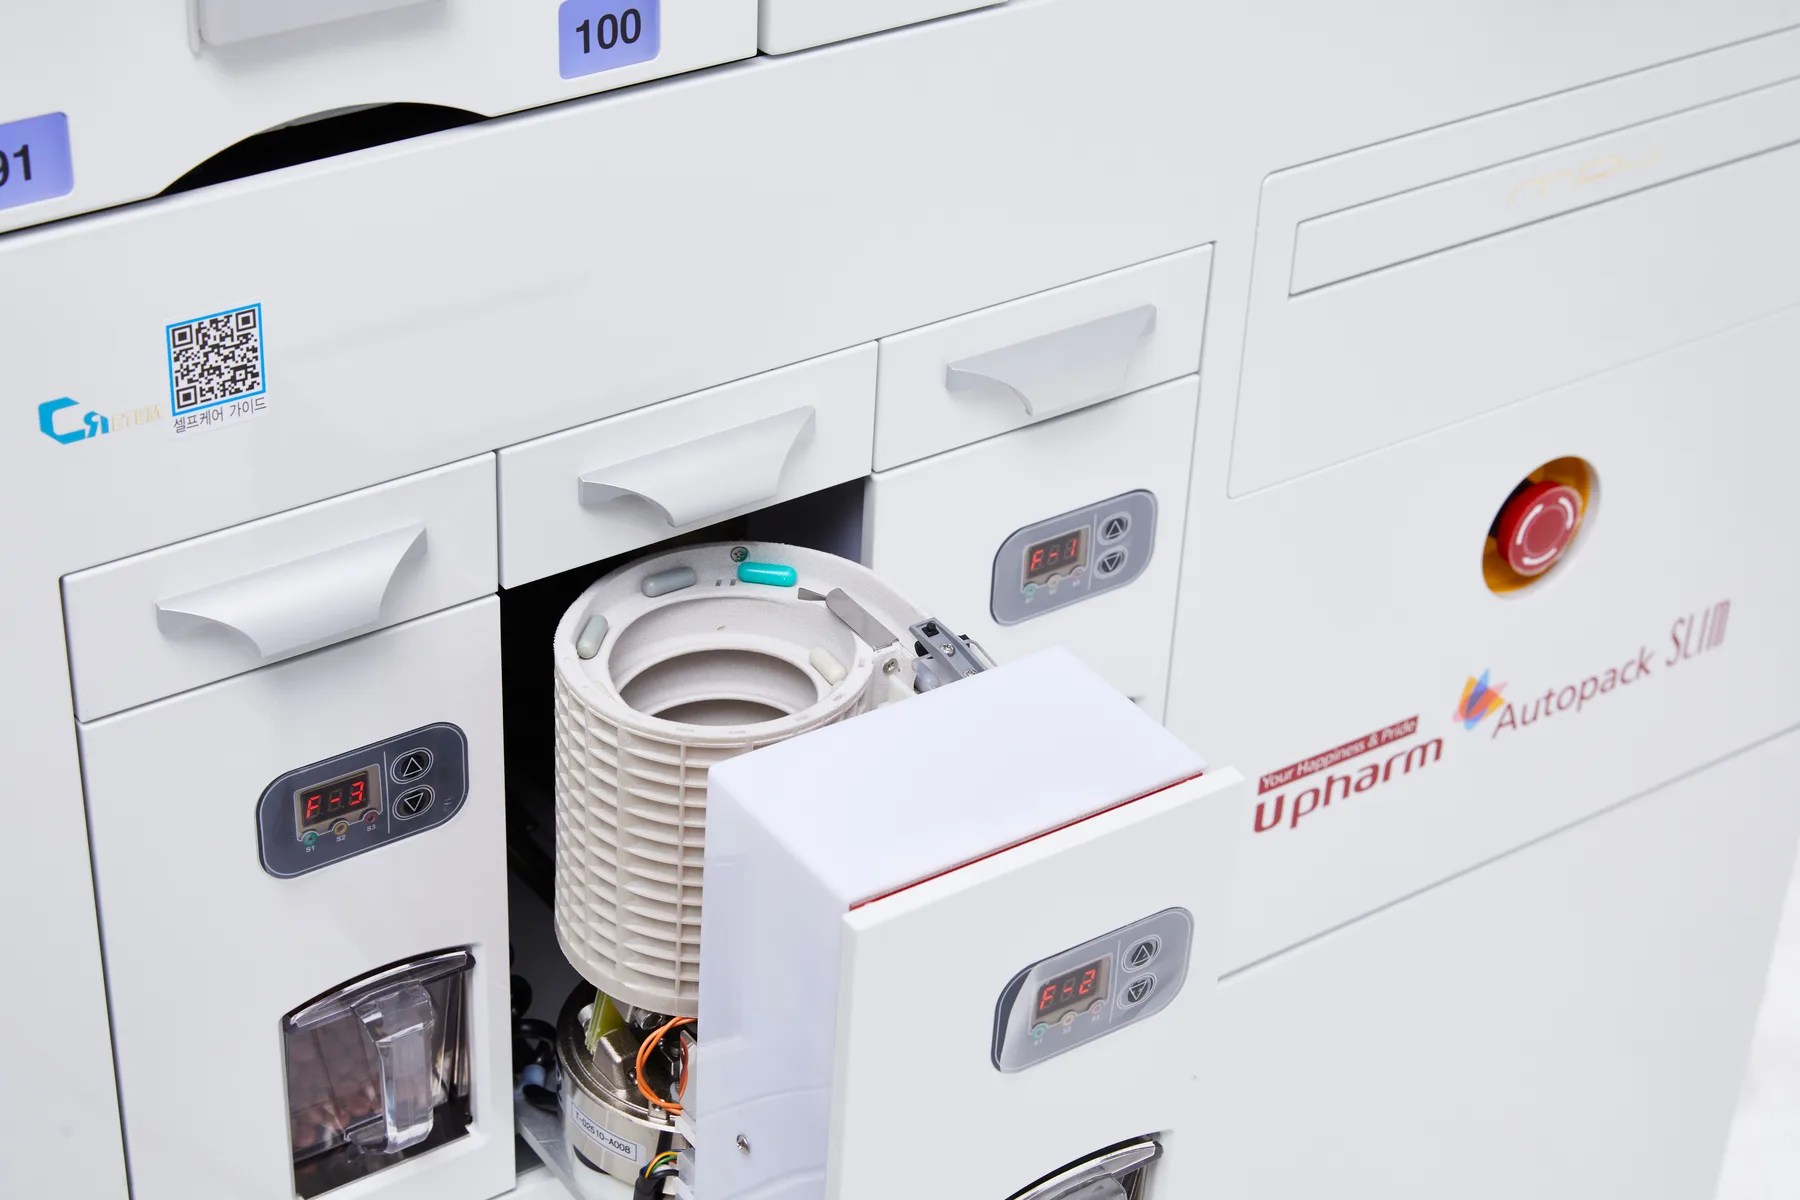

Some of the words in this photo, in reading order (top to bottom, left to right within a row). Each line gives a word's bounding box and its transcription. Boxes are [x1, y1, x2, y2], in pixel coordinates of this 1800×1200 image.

[575, 8, 642, 54] 100
[173, 406, 223, 434] 셀프케어
[229, 396, 267, 418] 가이드
[1030, 537, 1078, 571] F-1
[1492, 646, 1655, 740] Autopack
[1262, 767, 1295, 790] Your
[1296, 741, 1366, 776] Happiness
[1367, 733, 1380, 749] &
[1381, 719, 1416, 744] Pride
[306, 780, 365, 820] F-3
[1253, 737, 1444, 833] Upharm
[336, 834, 346, 842] S2
[1040, 968, 1097, 1011] F-2
